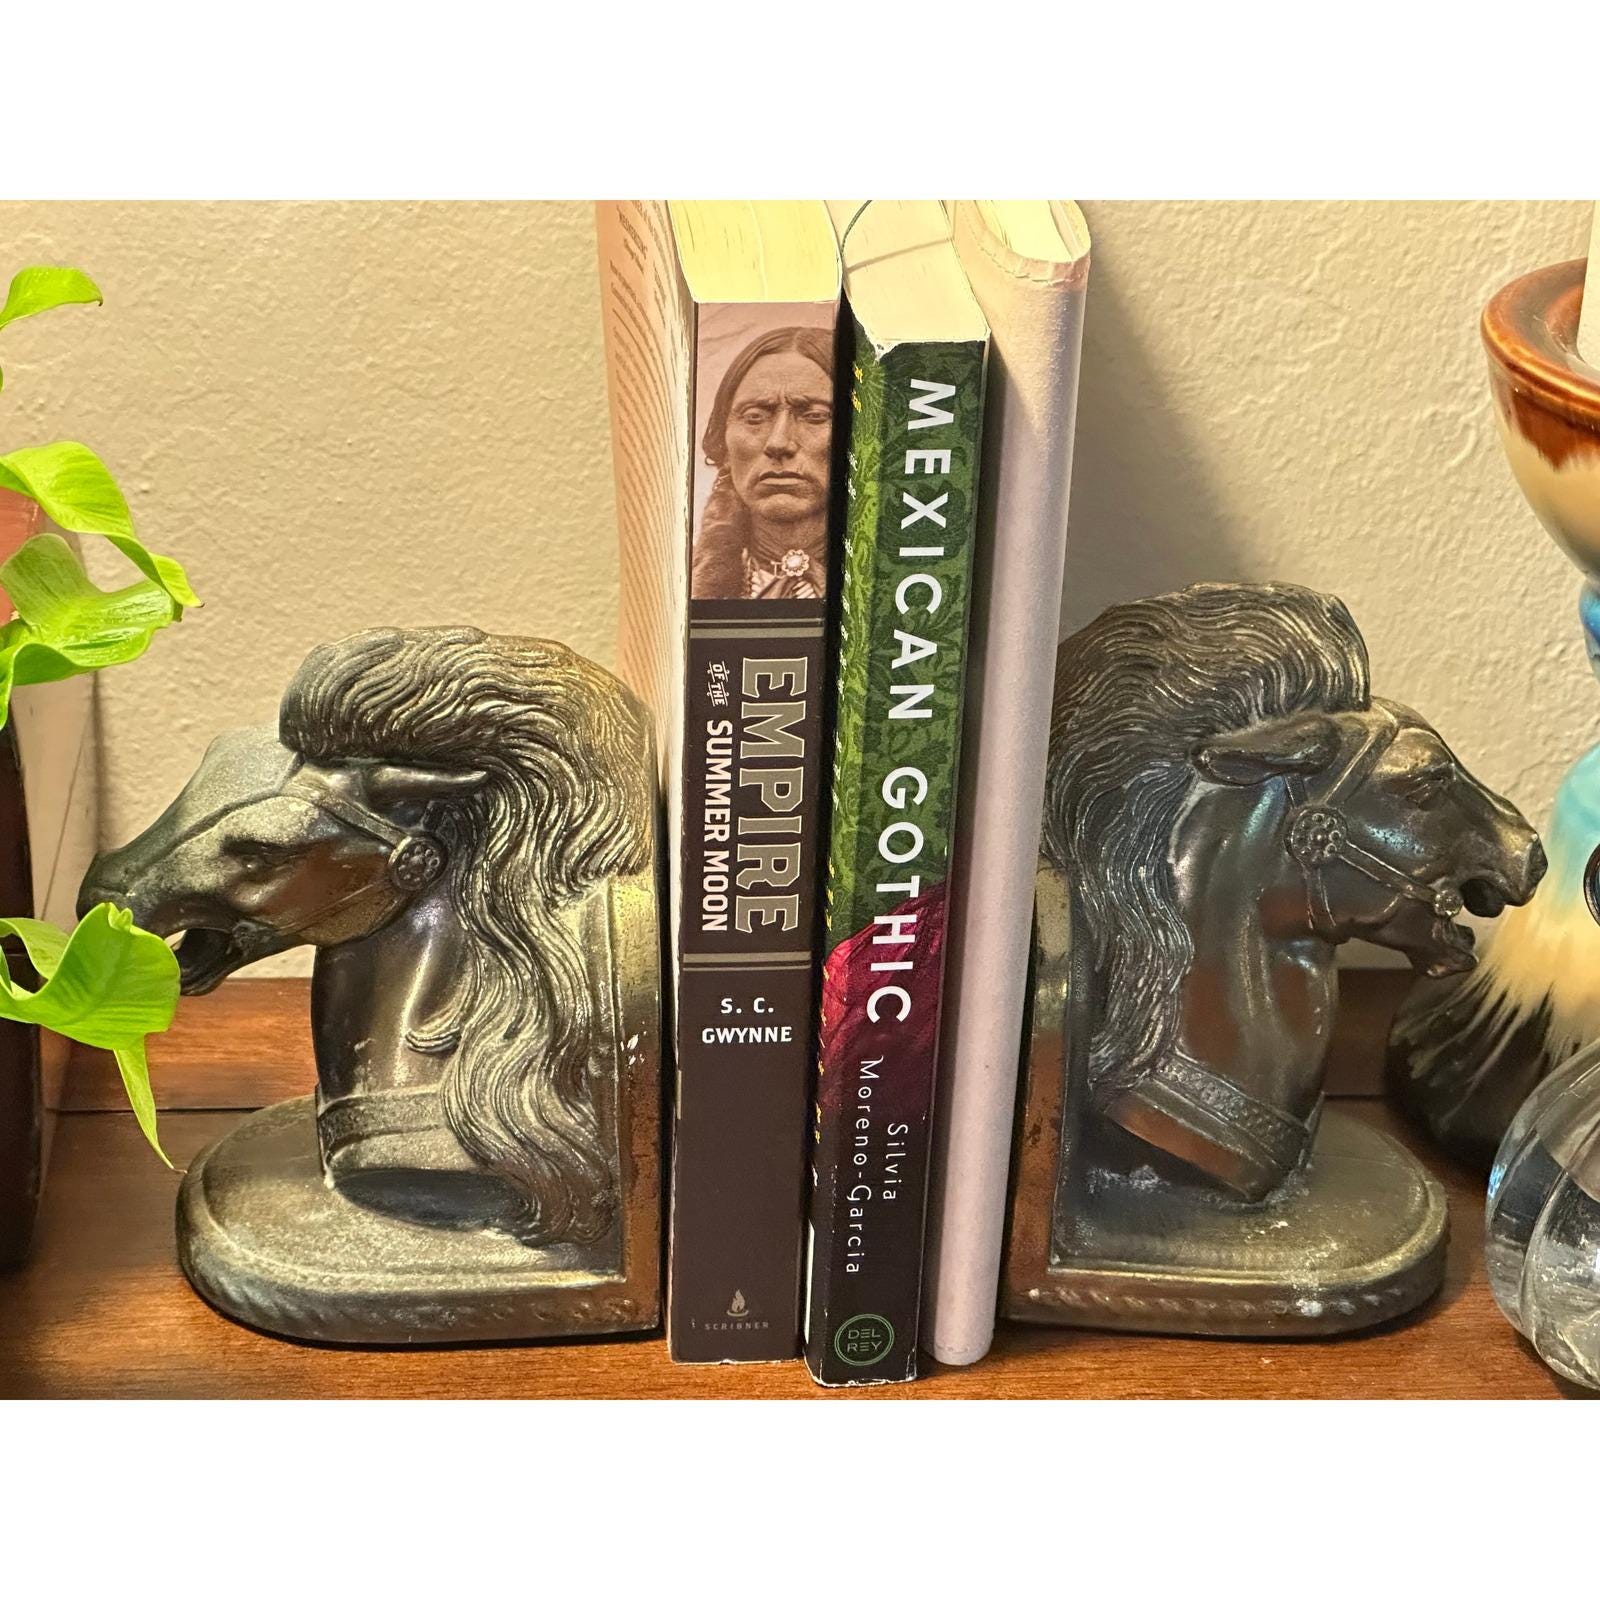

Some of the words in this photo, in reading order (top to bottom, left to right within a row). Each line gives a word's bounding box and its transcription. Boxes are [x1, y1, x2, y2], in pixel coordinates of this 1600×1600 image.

[887, 377, 957, 720] MEXICAN
[709, 661, 727, 682] OF
[709, 682, 727, 706] THE
[703, 719, 733, 842] SUMMER
[734, 656, 809, 934] EMPIRE
[701, 850, 730, 932] MOON
[866, 766, 928, 1023] GOTHIC
[720, 998, 742, 1014] S.
[752, 998, 775, 1014] C.
[701, 1025, 793, 1045] GWYNNE
[846, 1055, 884, 1274] Moreno-Garcia
[883, 1122, 908, 1201] Silvia
[704, 1321, 769, 1331] SCRIBNER
[846, 1341, 882, 1353] REY
[847, 1328, 881, 1340] DEL
